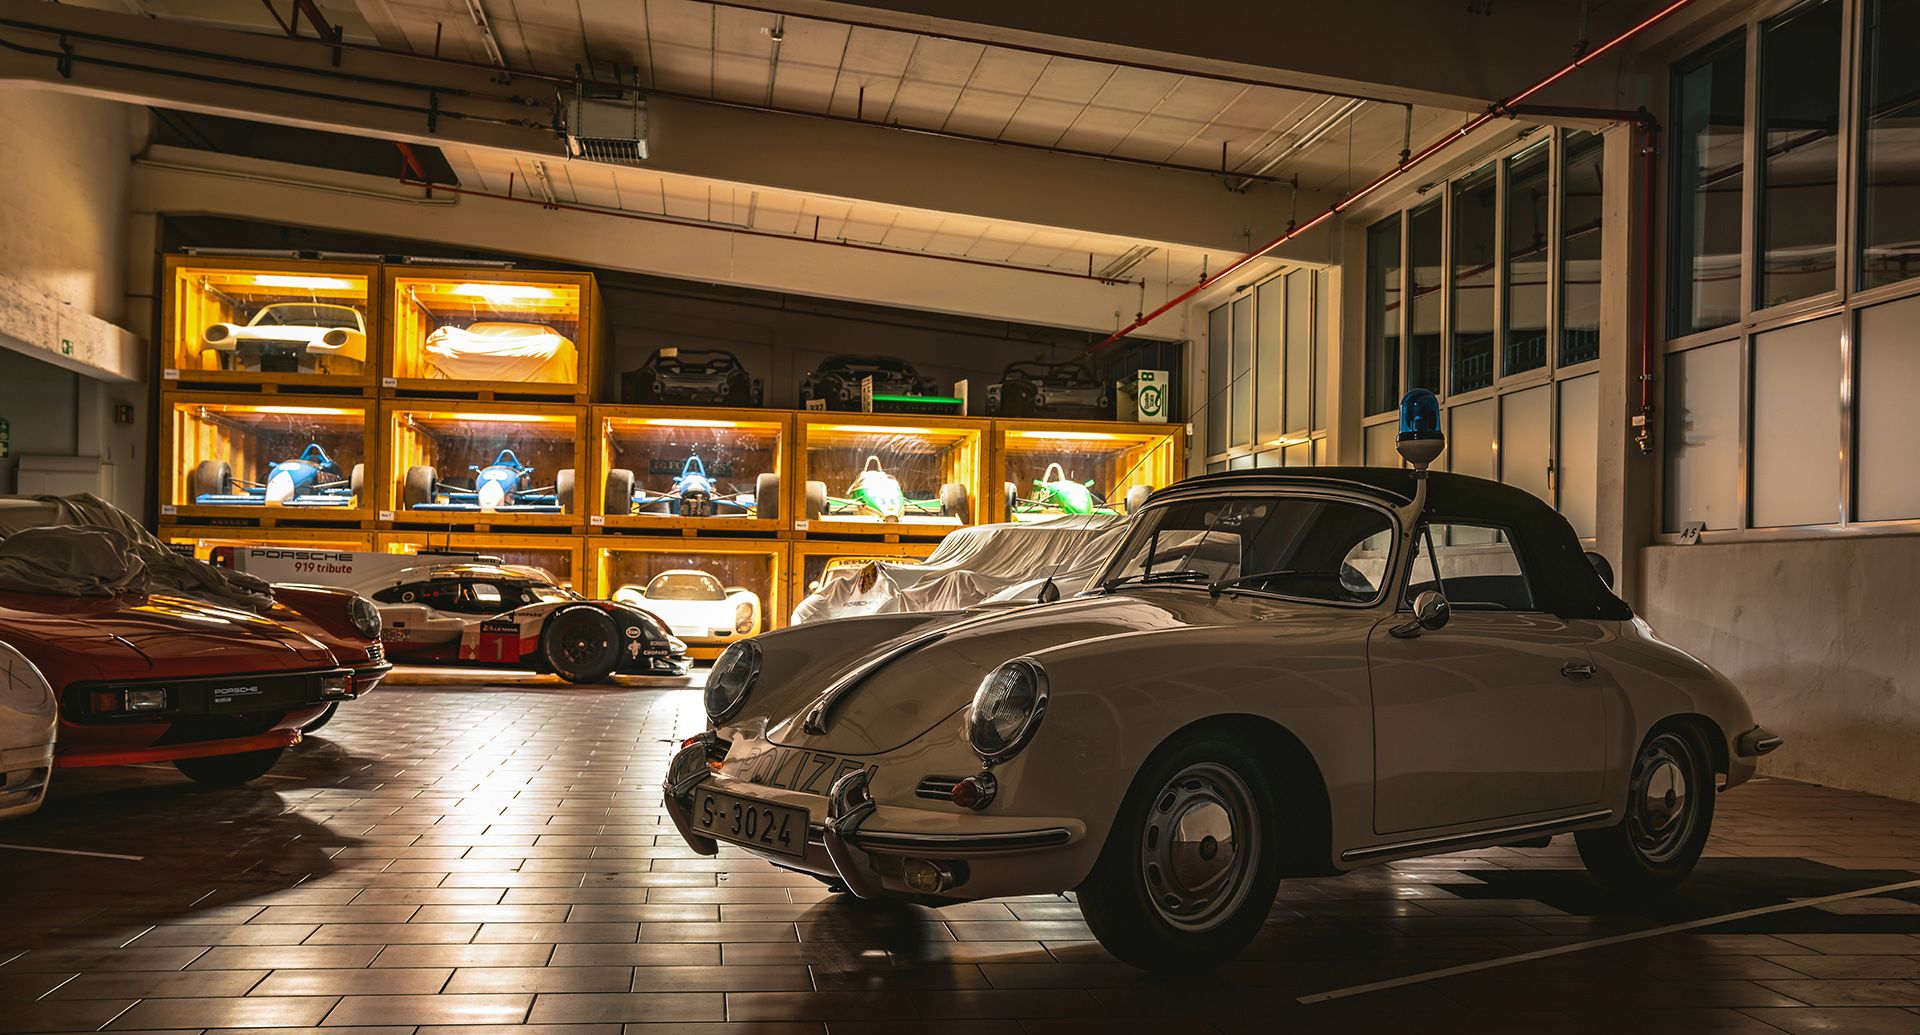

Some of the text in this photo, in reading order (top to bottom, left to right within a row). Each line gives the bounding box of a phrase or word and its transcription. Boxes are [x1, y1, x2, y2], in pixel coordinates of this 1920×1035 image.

[251, 550, 352, 561] PORSCHE
[295, 562, 352, 574] 919 tribute
[492, 637, 503, 660] 1
[214, 686, 259, 695] PORSCHE
[701, 794, 791, 848] S-3024
